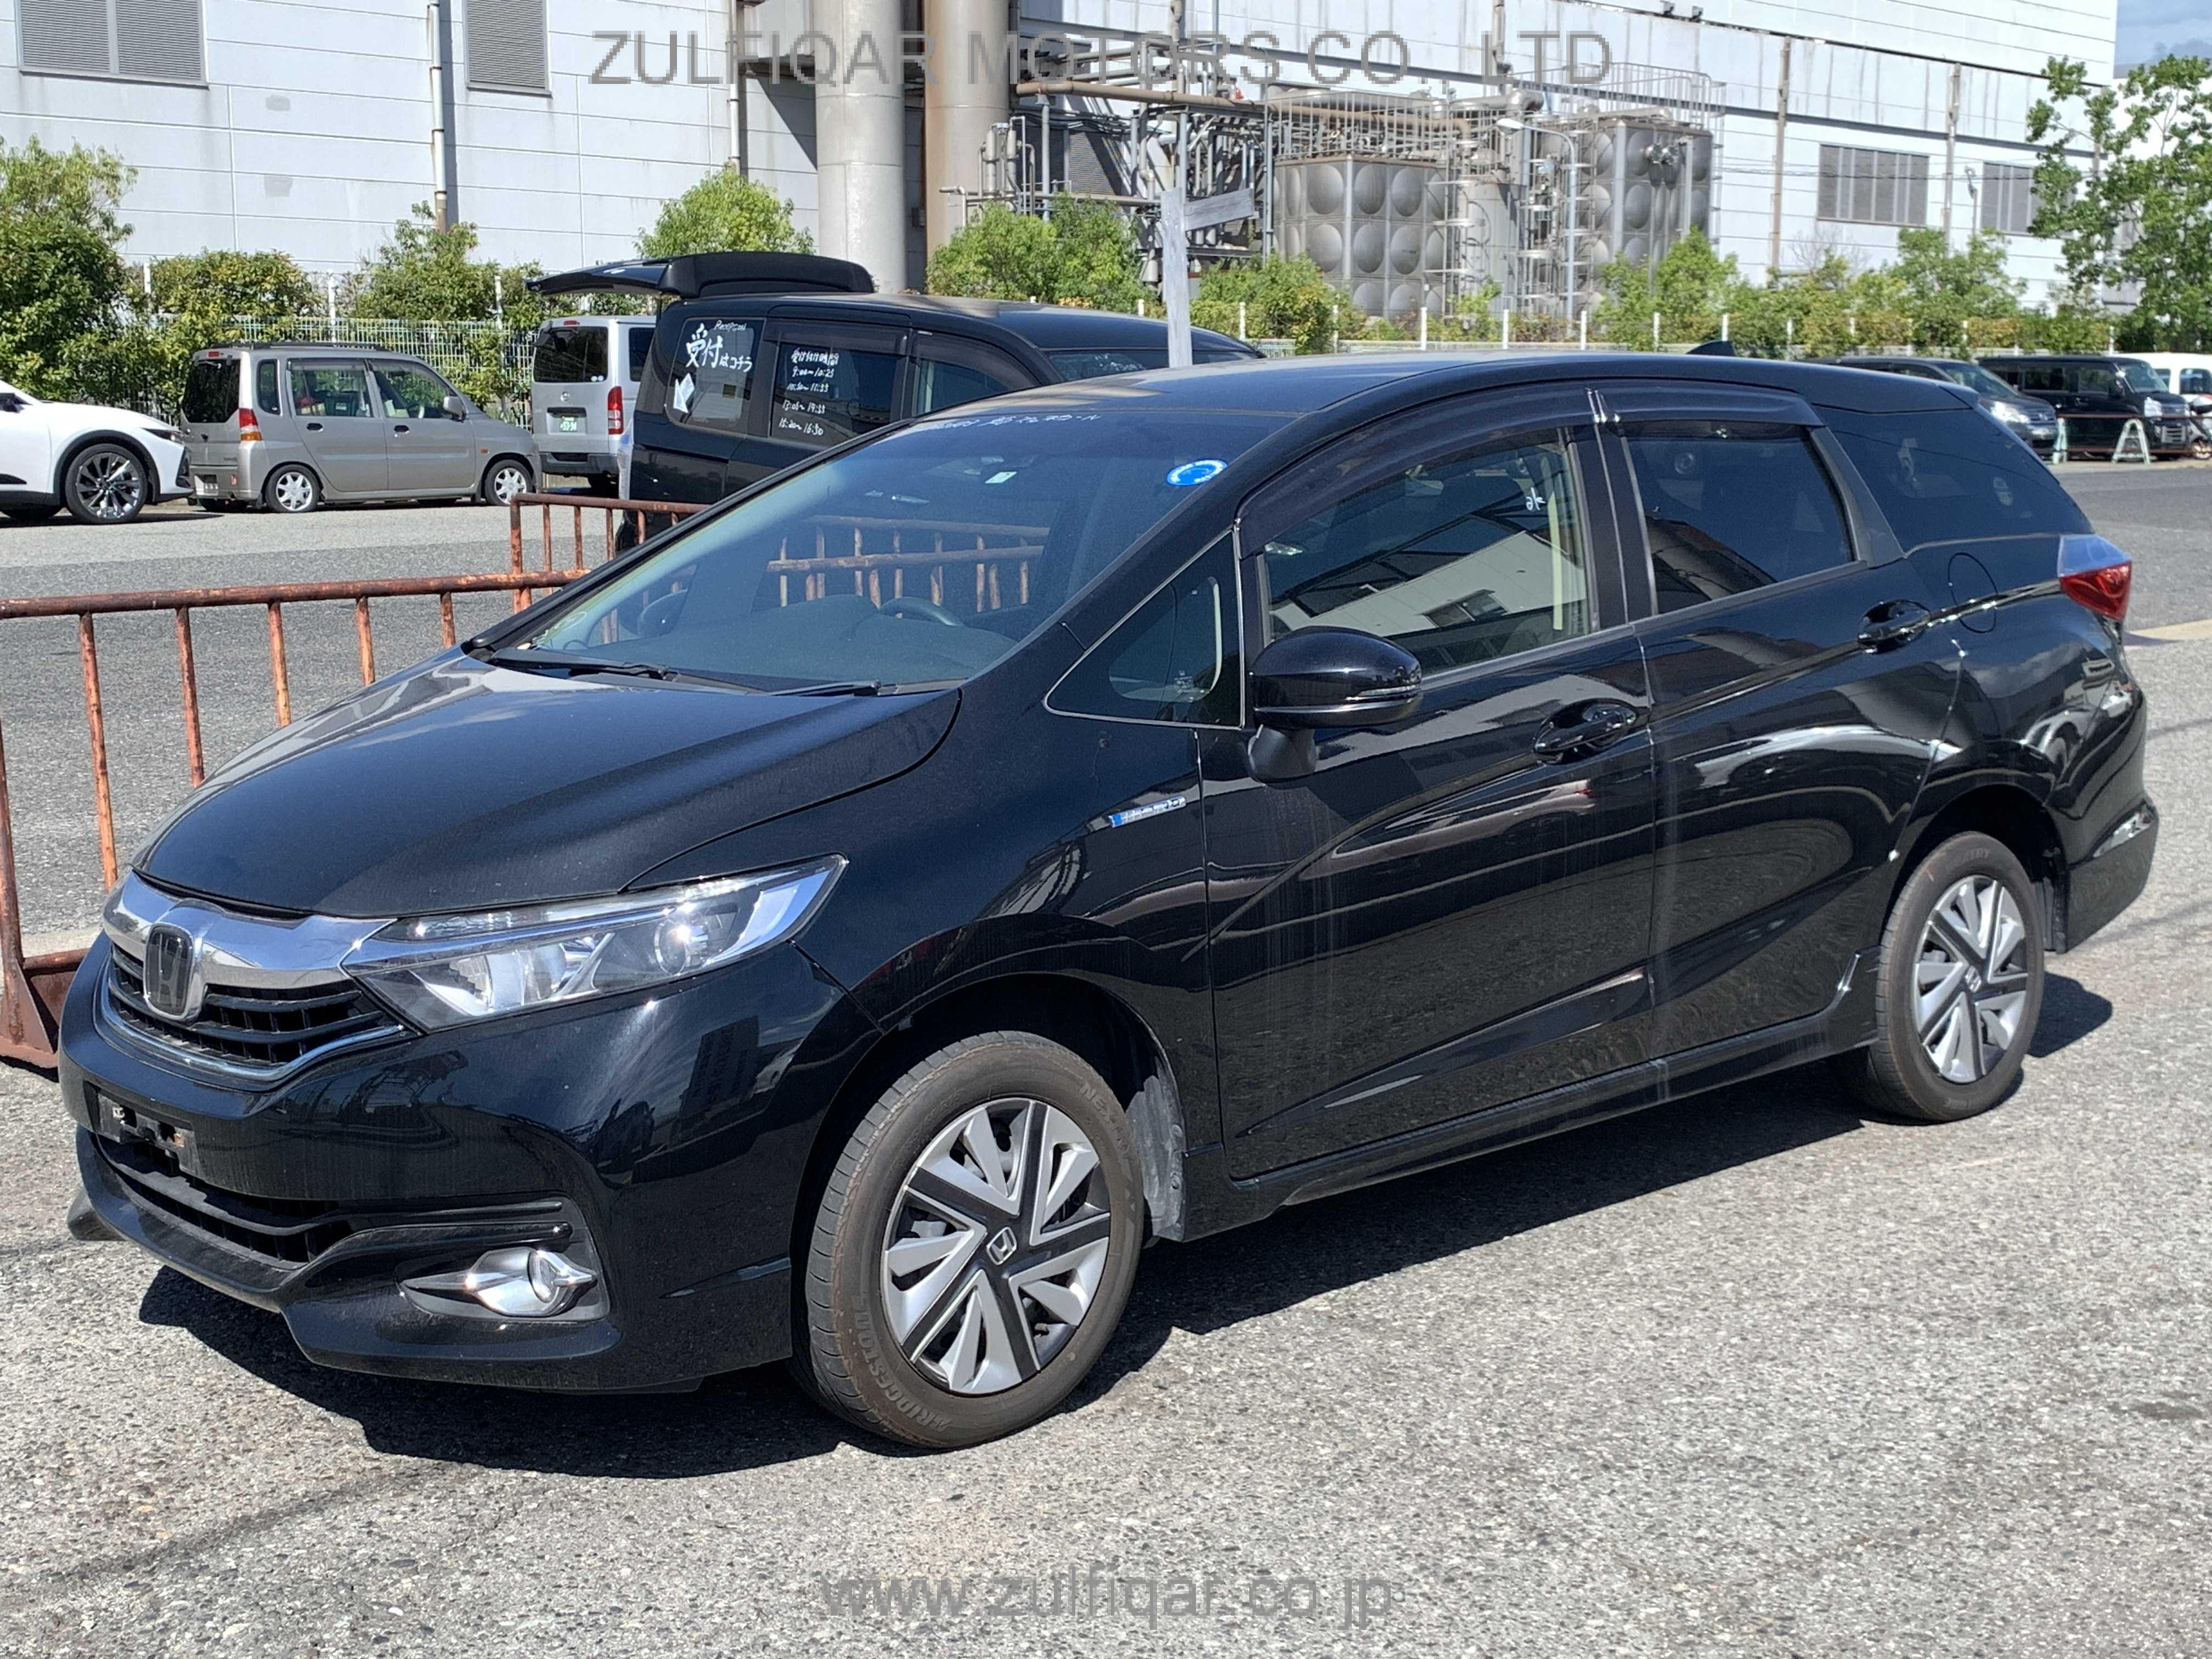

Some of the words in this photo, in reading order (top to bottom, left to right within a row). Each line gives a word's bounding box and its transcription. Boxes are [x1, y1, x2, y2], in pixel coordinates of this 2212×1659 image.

[685, 323, 753, 373] 受付はコチラ
